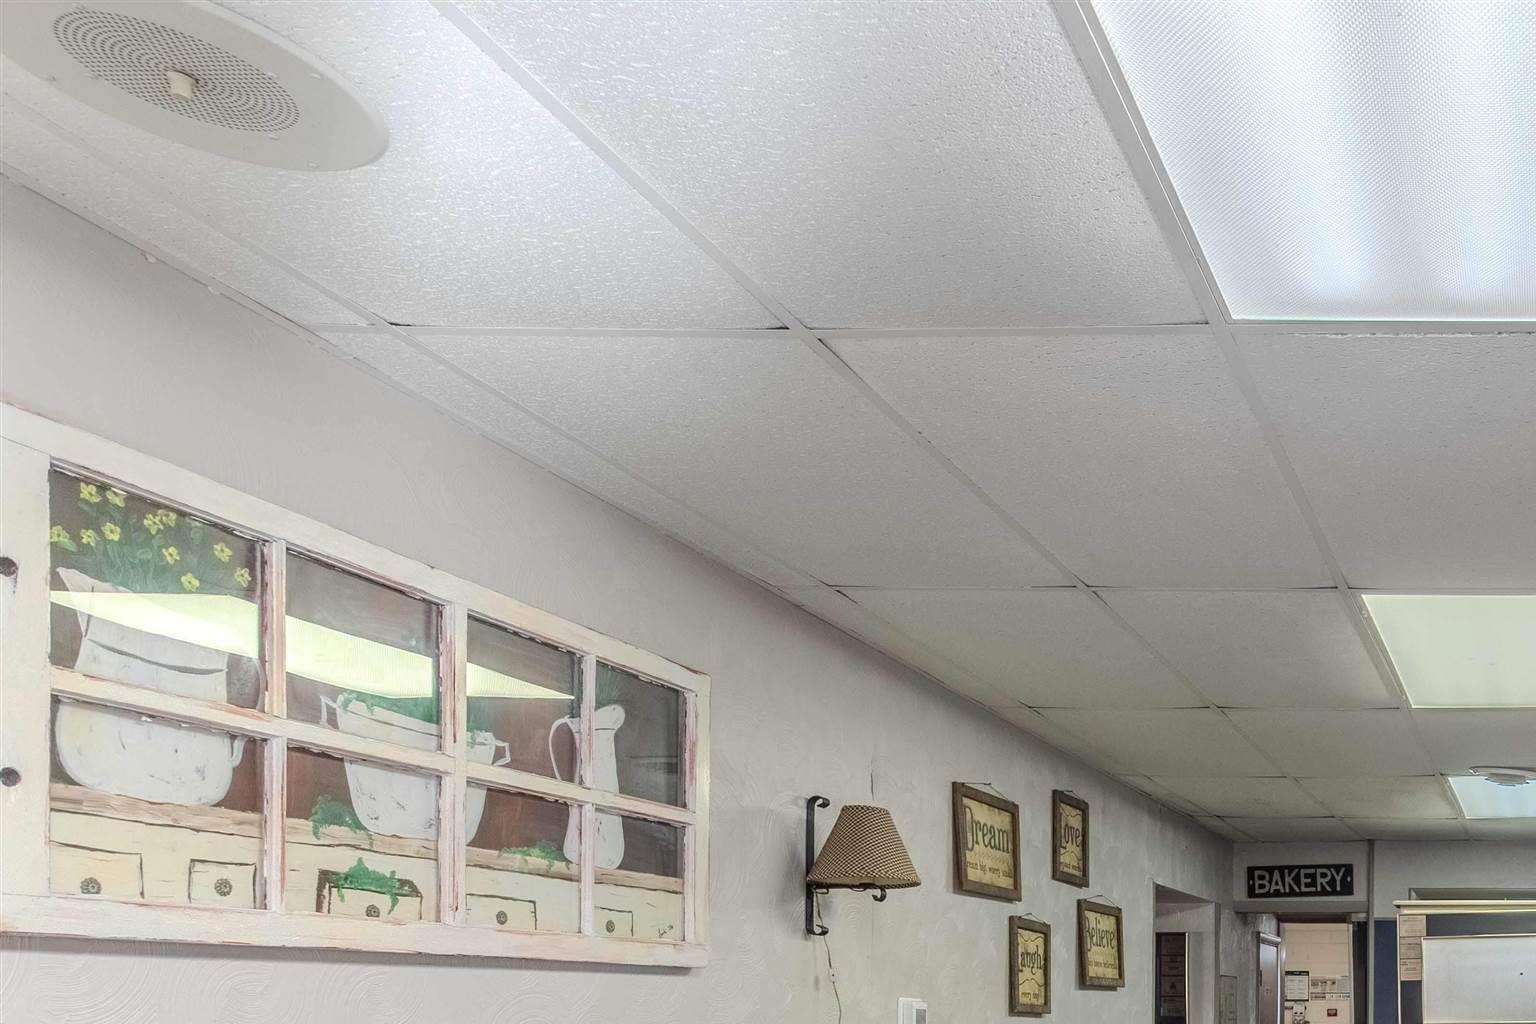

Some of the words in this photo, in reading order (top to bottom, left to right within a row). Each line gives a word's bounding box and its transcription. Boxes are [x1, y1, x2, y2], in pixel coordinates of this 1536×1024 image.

[964, 806, 1010, 854] Dream
[1254, 867, 1346, 894] BAKERY
[1085, 916, 1116, 952] Believe
